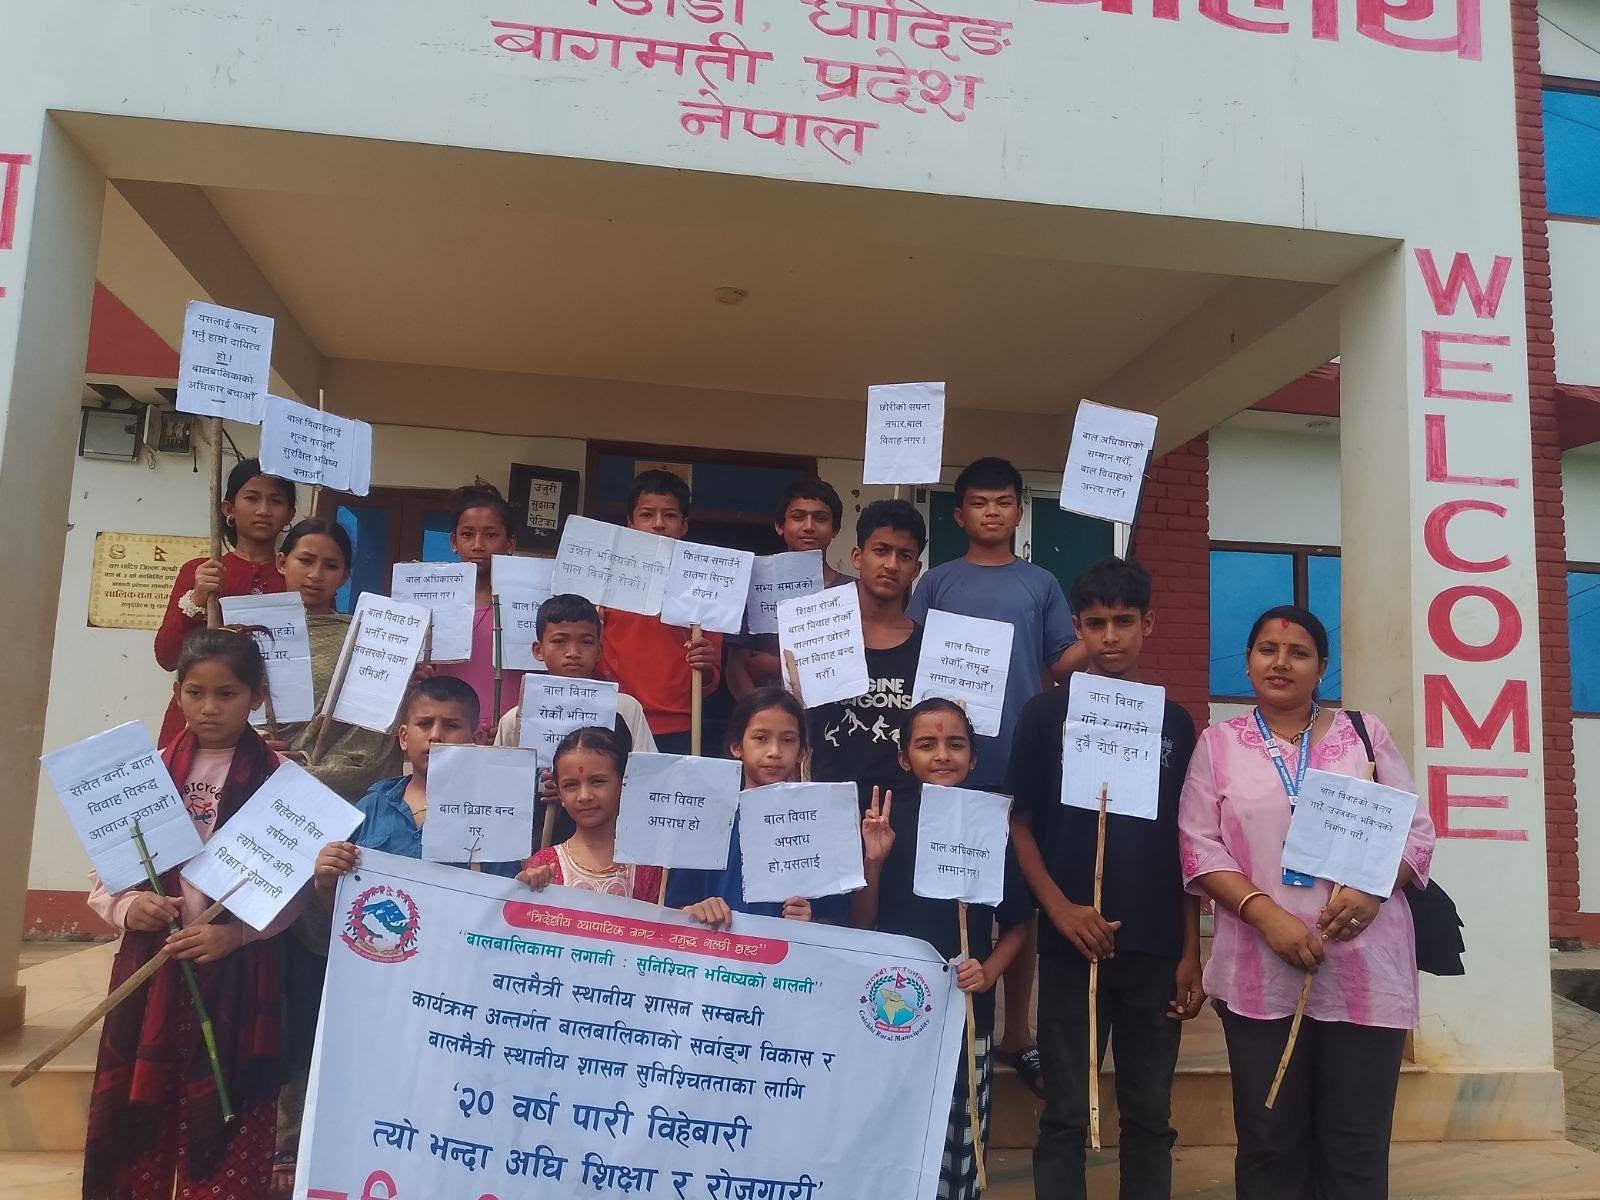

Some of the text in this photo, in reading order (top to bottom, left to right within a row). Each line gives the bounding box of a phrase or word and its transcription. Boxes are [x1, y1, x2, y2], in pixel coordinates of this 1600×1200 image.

[490, 19, 985, 122] बागमती प्रदेश
[679, 89, 879, 165] नेपाल
[187, 380, 225, 394] अधिकार
[879, 401, 931, 412] छोरीको सपना
[880, 435, 902, 446] विवाह
[1082, 431, 1144, 451] बाल अधिकारको
[1087, 449, 1114, 462] सम्मान
[1081, 464, 1134, 482] बाल विवाहको
[1413, 248, 1530, 841] WELCOME
[684, 550, 710, 564] किताब
[405, 573, 465, 584] बाल अधिकारको
[683, 569, 708, 581] हातमा
[413, 592, 438, 600] सम्मान
[944, 640, 991, 657] बाल विवाह
[868, 677, 905, 694] GINE
[929, 672, 957, 686] समाज
[543, 684, 598, 699] बाल विवाह
[1089, 691, 1145, 712] बाल विवाह
[567, 708, 598, 722] भविष्य
[1103, 718, 1111, 729] र
[70, 776, 101, 798] सचेत
[131, 754, 155, 770] बाल
[87, 795, 122, 816] विवाह
[648, 791, 706, 808] बाल विवाह
[440, 804, 461, 814] बाल
[763, 809, 818, 825] बाल विवाह
[89, 815, 129, 841] आवाज
[648, 816, 701, 831] अपराध हो
[774, 834, 811, 848] अपराध
[930, 841, 991, 860] बाल अधिकारको
[937, 864, 966, 877] सम्मान
[570, 949, 616, 967] लगानी
[636, 954, 699, 980] सुनिश्चित
[704, 965, 767, 989] भविष्यको
[493, 971, 765, 1028] बालमैत्री स्थानीय शासन सम्बन्धी
[412, 990, 478, 1021] कार्यक्रम
[485, 1007, 552, 1033] अन्तर्गत
[558, 1018, 682, 1051] बालबालिकाको
[760, 1040, 815, 1068] विकास
[822, 1051, 836, 1072] र
[875, 1031, 893, 1042] Rural
[894, 1018, 930, 1042] Municipality
[429, 1030, 806, 1100] बालमैत्री स्थानीय शासन सुनिश्चितताका लागि
[512, 1091, 561, 1126] वर्ष
[572, 1100, 635, 1139] पारी
[372, 1118, 420, 1152] त्यो
[430, 1133, 495, 1172] भन्दा
[505, 1144, 569, 1182] अघि
[582, 1151, 659, 1193] शिक्षा
[672, 1170, 694, 1200] र
